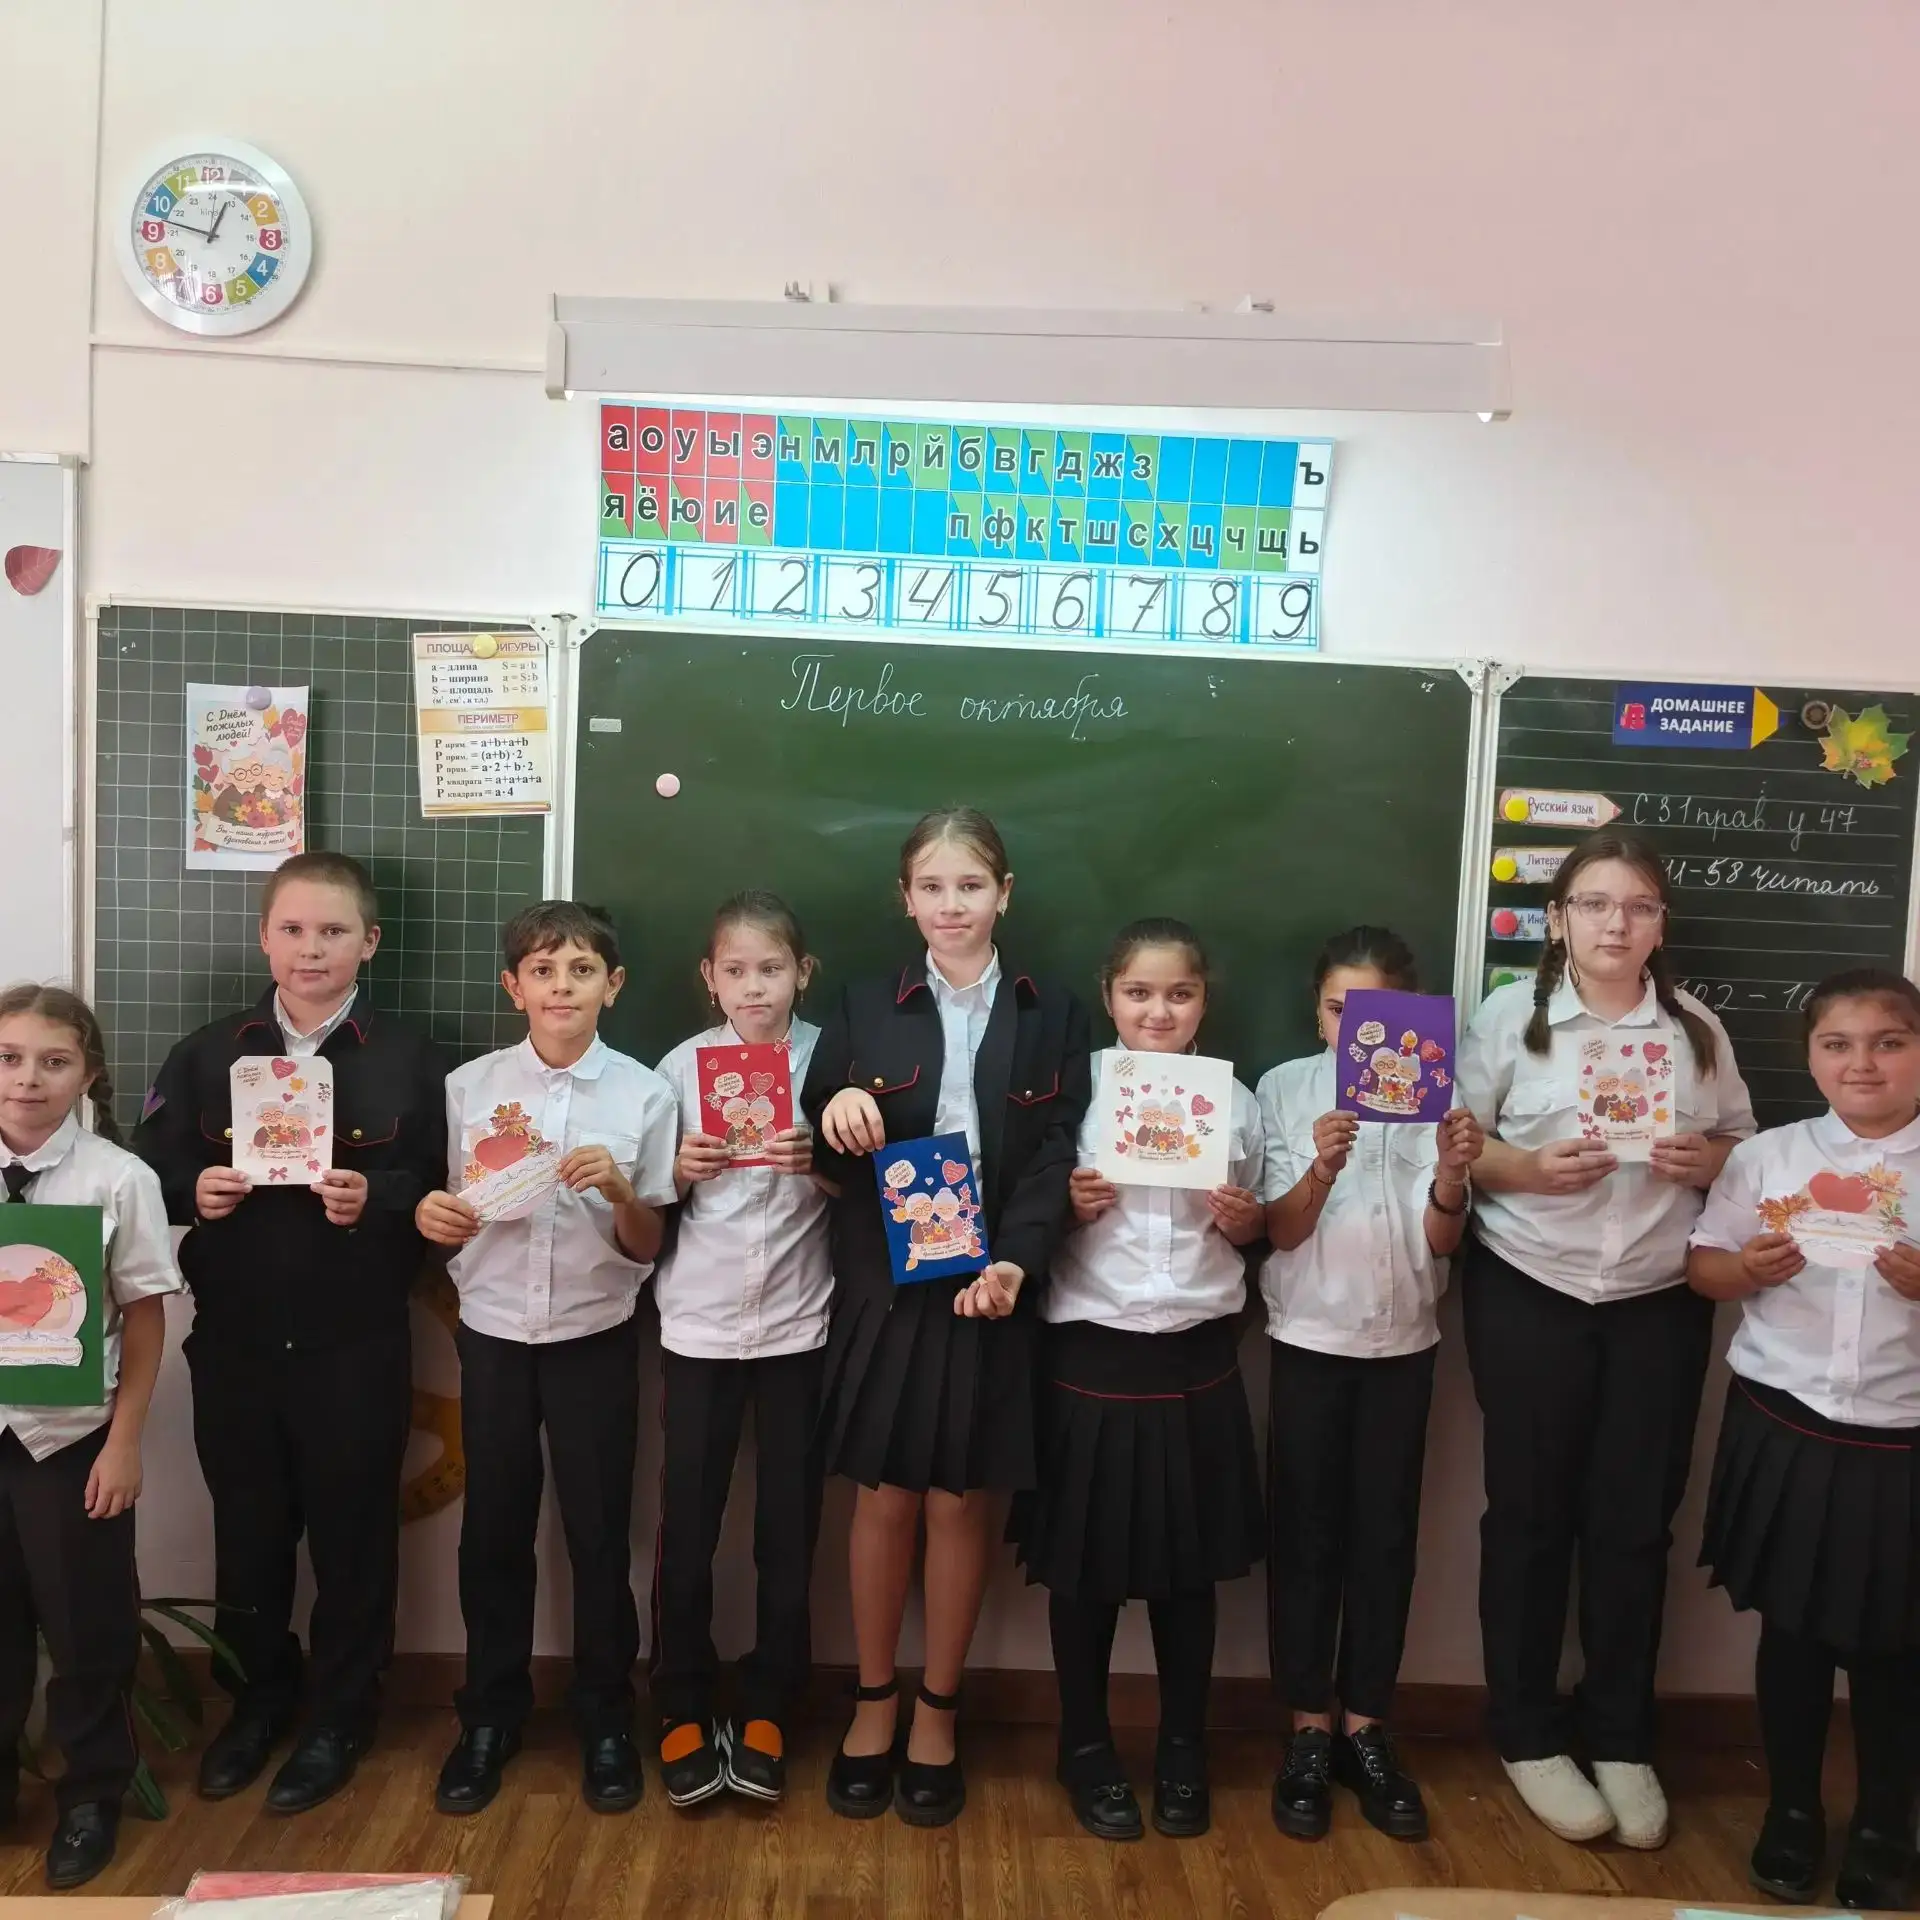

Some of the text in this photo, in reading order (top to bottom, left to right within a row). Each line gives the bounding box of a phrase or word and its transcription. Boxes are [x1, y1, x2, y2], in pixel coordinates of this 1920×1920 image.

[203, 168, 221, 184] 12
[152, 195, 171, 213] 10
[189, 198, 199, 206] 23
[227, 200, 236, 208] 13
[256, 200, 269, 218] 2
[175, 209, 185, 218] 22
[240, 214, 249, 222] 14
[147, 223, 159, 240] 9
[246, 234, 255, 242] 15
[265, 231, 277, 249] 3
[175, 249, 185, 257] 20
[240, 253, 248, 261] 16
[155, 252, 166, 270] 8
[256, 259, 269, 277] 4
[208, 270, 217, 278] 18
[227, 266, 236, 274] 17
[205, 286, 217, 303] 6
[235, 279, 247, 297] 5
[608, 425, 1324, 485] а о у ы э н м л р й б в г д ж з ъ
[604, 487, 1319, 559] я ё ю и е п ф к т ш с х ц ч щ ь
[620, 553, 1312, 639] 0 1 2 3 4 5 6 7 8 9
[426, 642, 540, 654] ПЛОЩА ИГУРЫ
[447, 664, 478, 672] длина
[502, 661, 508, 670] S
[449, 674, 489, 685] ширина
[432, 686, 439, 695] S
[449, 687, 494, 697] площадь
[780, 654, 1129, 741] Первое октября
[1650, 698, 1746, 714] ДОМАШНЕЕ
[206, 709, 248, 722] С Днём
[458, 713, 519, 724] ПЕРИМЕТР
[206, 719, 254, 732] пожилых
[1660, 717, 1734, 734] ЗАДАНИЕ
[215, 728, 251, 742] людей!
[447, 791, 483, 799] квадрата
[1528, 796, 1594, 815] Русский язык
[1633, 792, 1649, 824] С
[1820, 806, 1858, 833] 47
[1750, 865, 1881, 896] читать
